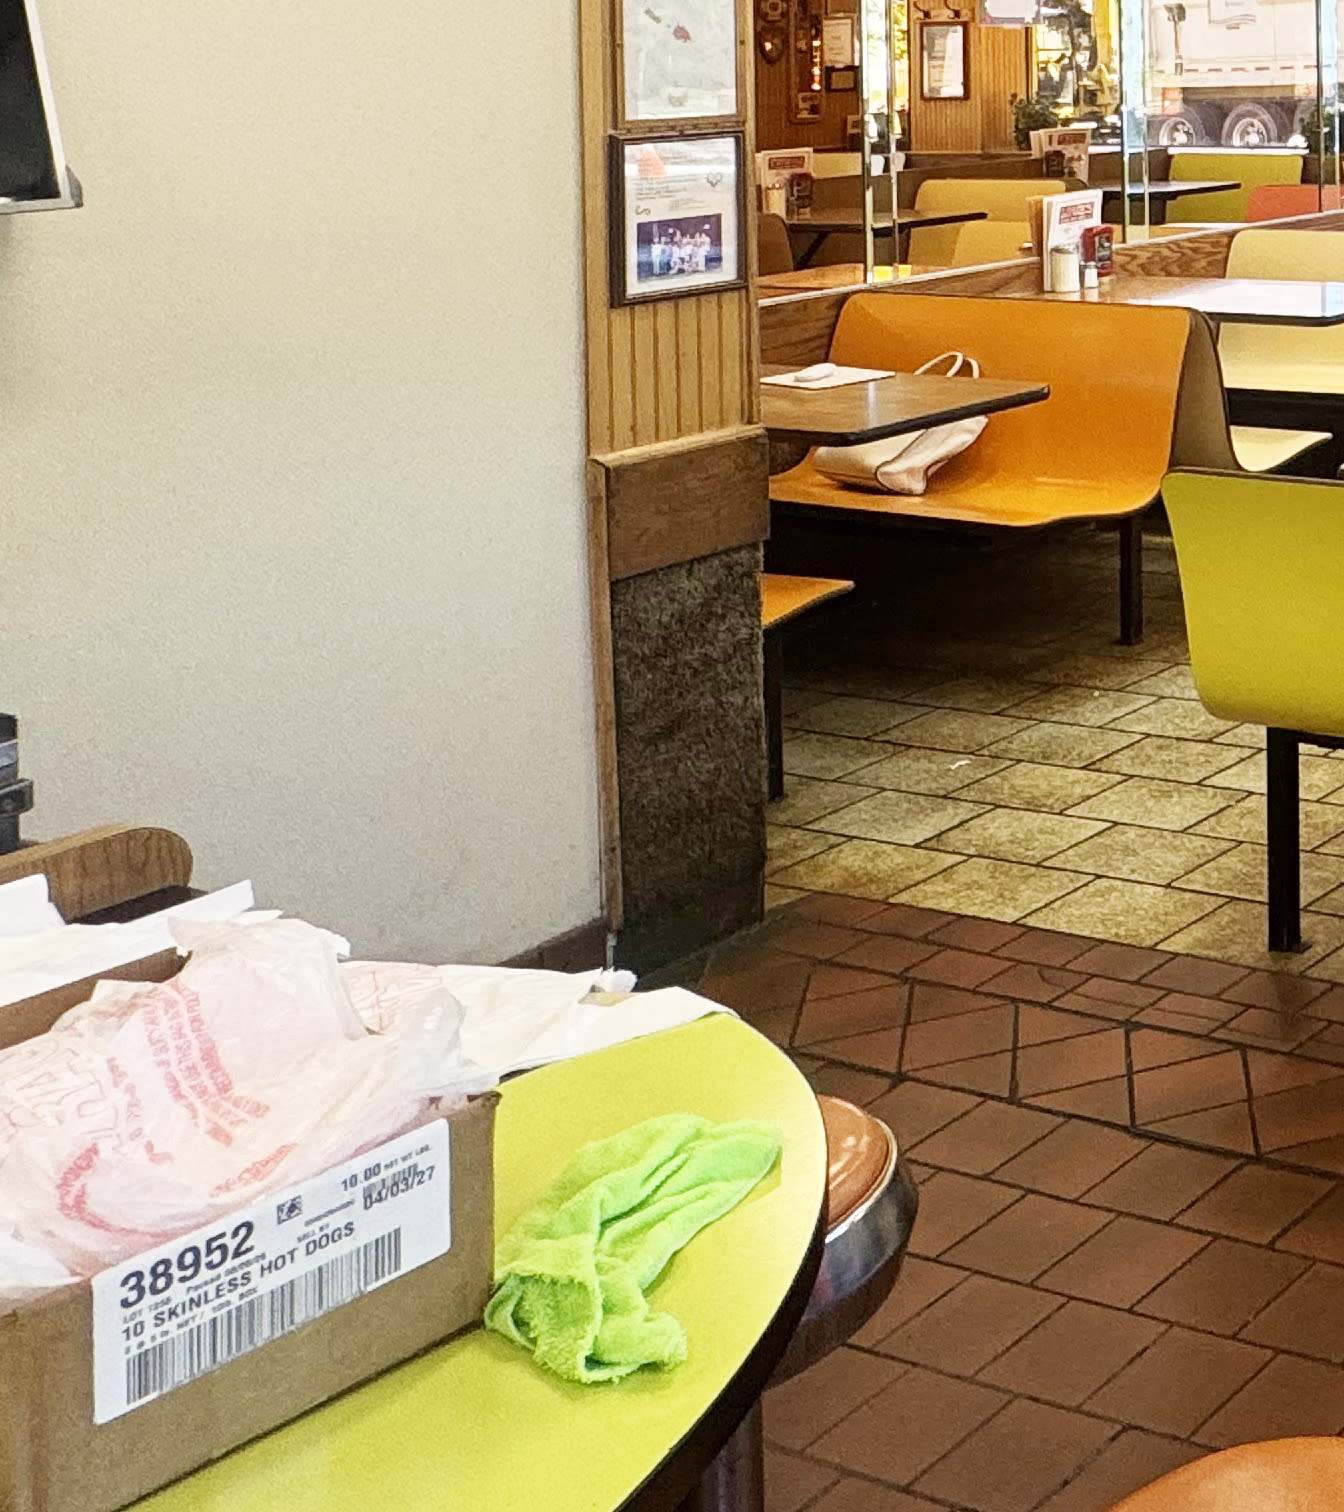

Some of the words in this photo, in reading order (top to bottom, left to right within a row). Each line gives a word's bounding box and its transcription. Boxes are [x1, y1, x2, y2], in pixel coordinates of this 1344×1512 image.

[340, 1162, 382, 1192] 10.00
[120, 1220, 255, 1309] 38952
[121, 1321, 145, 1341] 10
[153, 1270, 251, 1328] SKINLESS
[260, 1247, 299, 1278] HOT
[305, 1221, 355, 1257] DOGS
[123, 1309, 143, 1325] LOT
